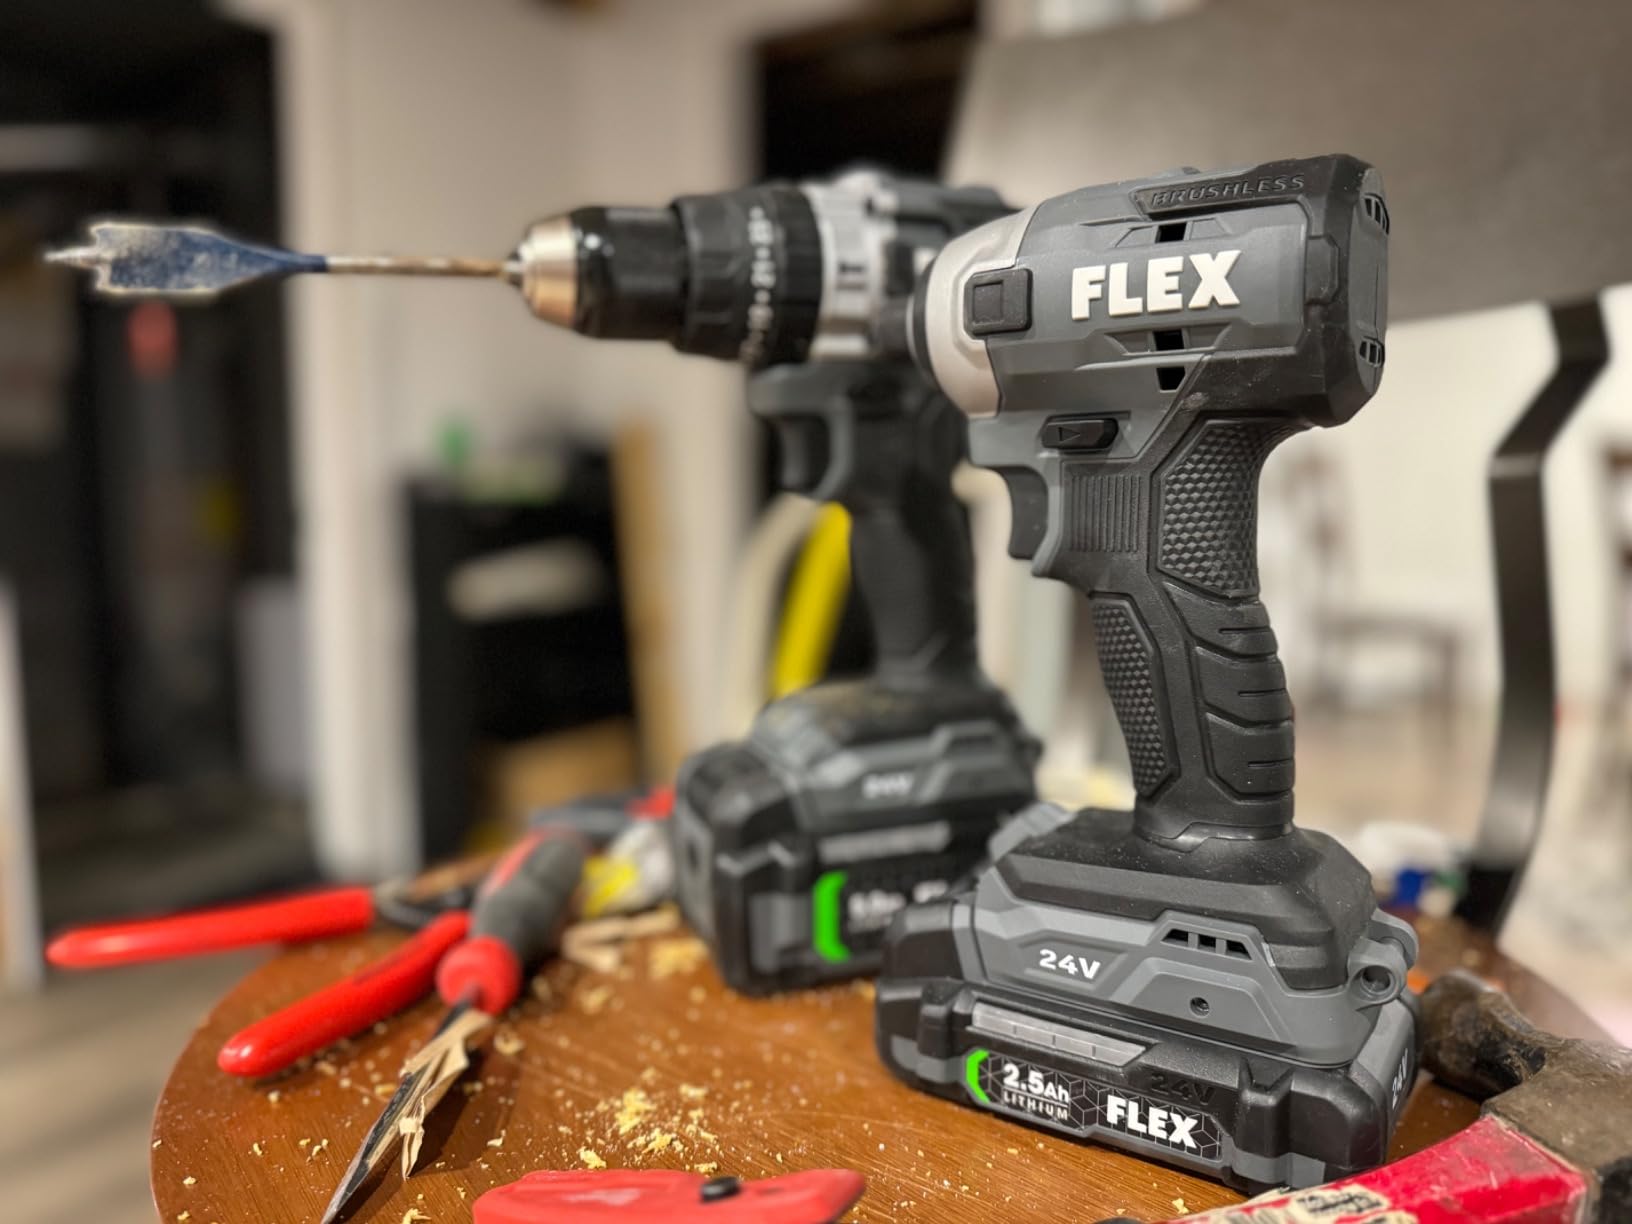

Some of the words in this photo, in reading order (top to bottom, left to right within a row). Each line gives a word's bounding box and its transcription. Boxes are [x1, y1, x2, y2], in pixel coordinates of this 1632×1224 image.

[1151, 175, 1304, 207] BRUSHLESS
[1071, 250, 1242, 321] FLEX
[1039, 948, 1101, 980] 24V
[1003, 1063, 1069, 1103] 2.5Ah
[1003, 1090, 1068, 1121] LITHIUM
[1106, 1093, 1198, 1149] FLEX
